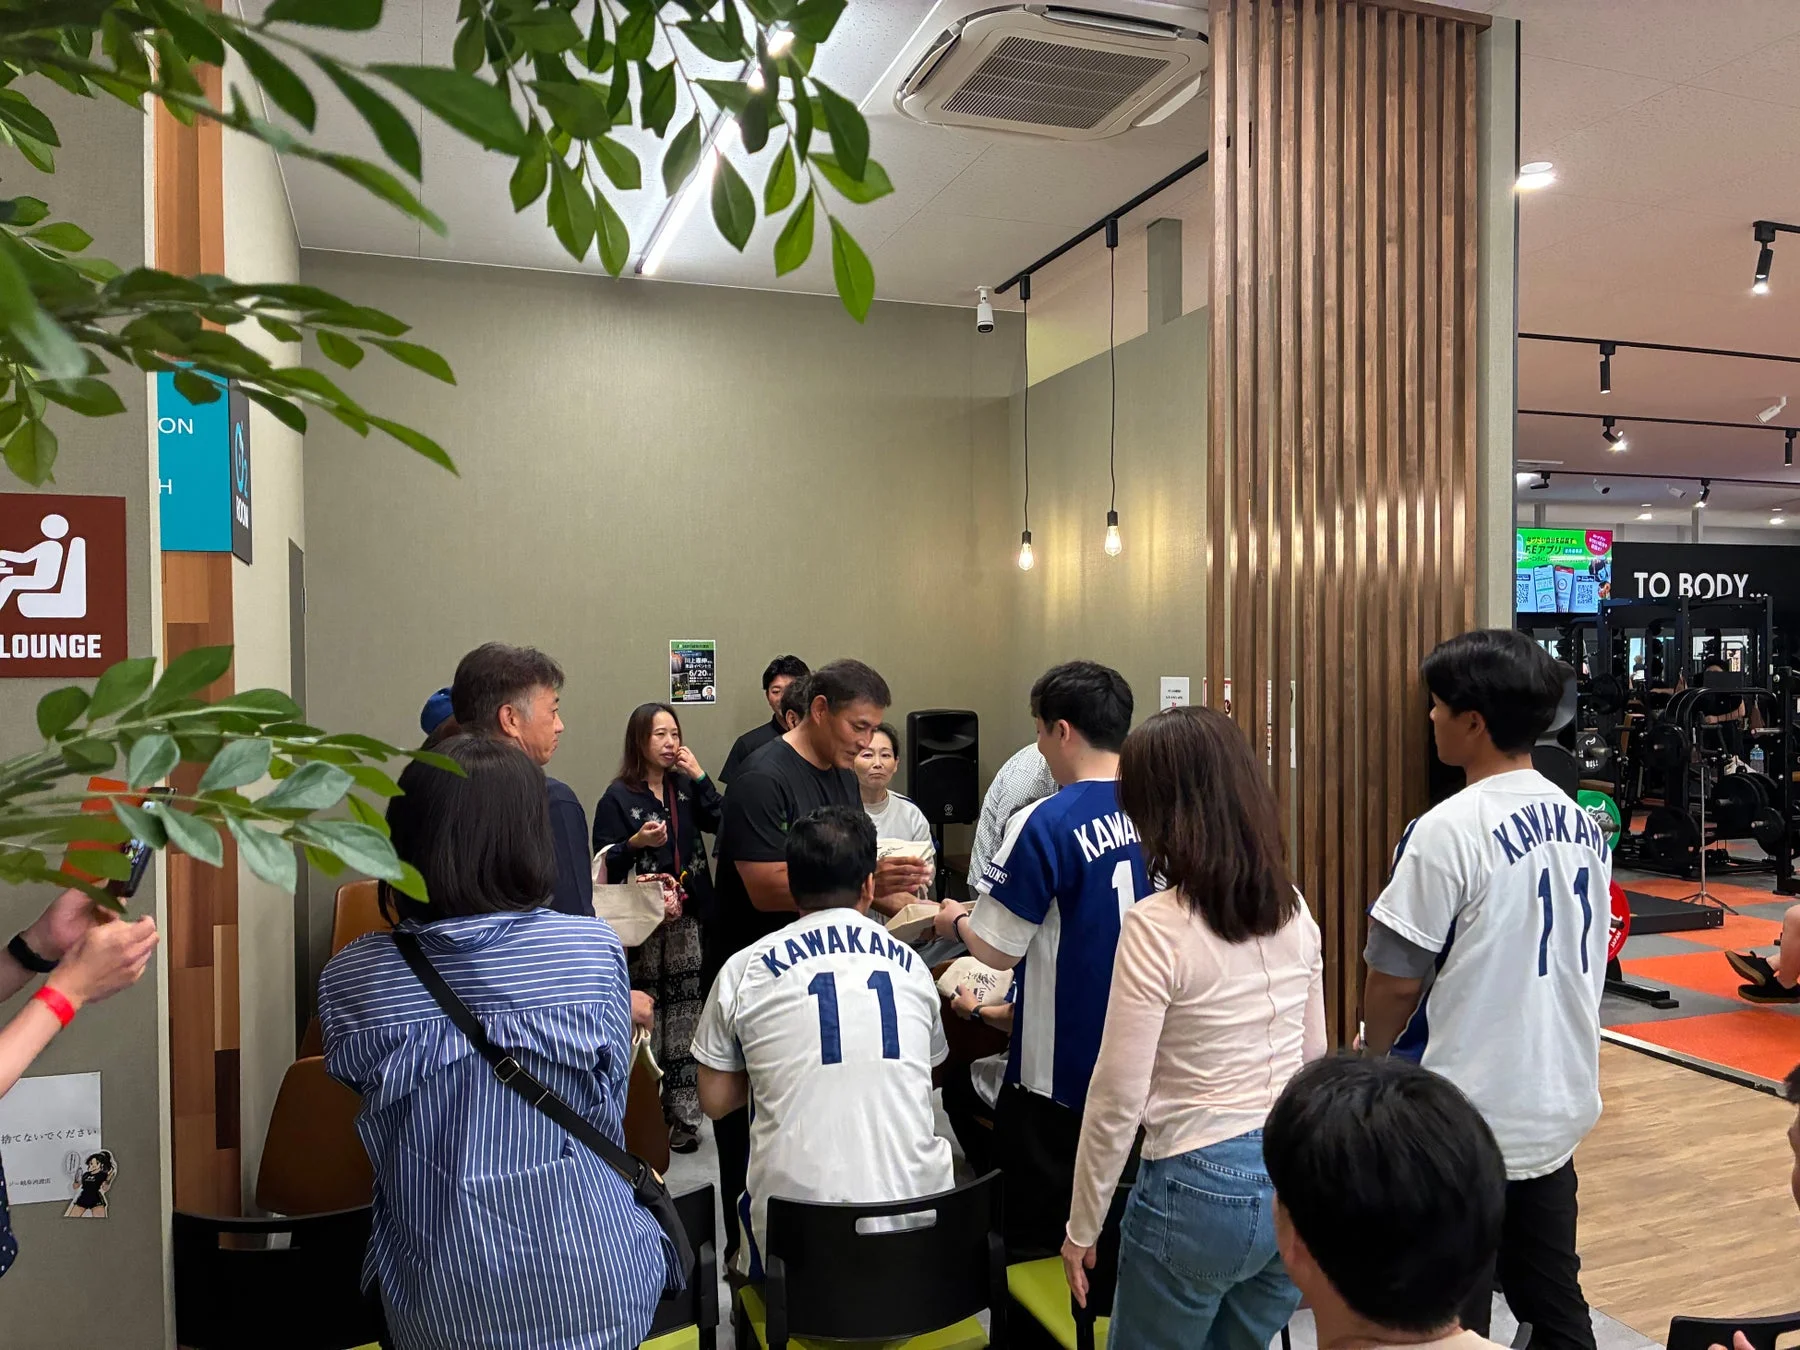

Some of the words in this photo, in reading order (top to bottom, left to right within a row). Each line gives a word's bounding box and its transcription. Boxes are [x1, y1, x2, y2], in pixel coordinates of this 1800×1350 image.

[1634, 572, 1671, 598] TO
[1073, 811, 1142, 863] KAWA
[1537, 867, 1592, 977] 11
[761, 925, 913, 978] KAWAKAMI
[808, 970, 900, 1066] 11
